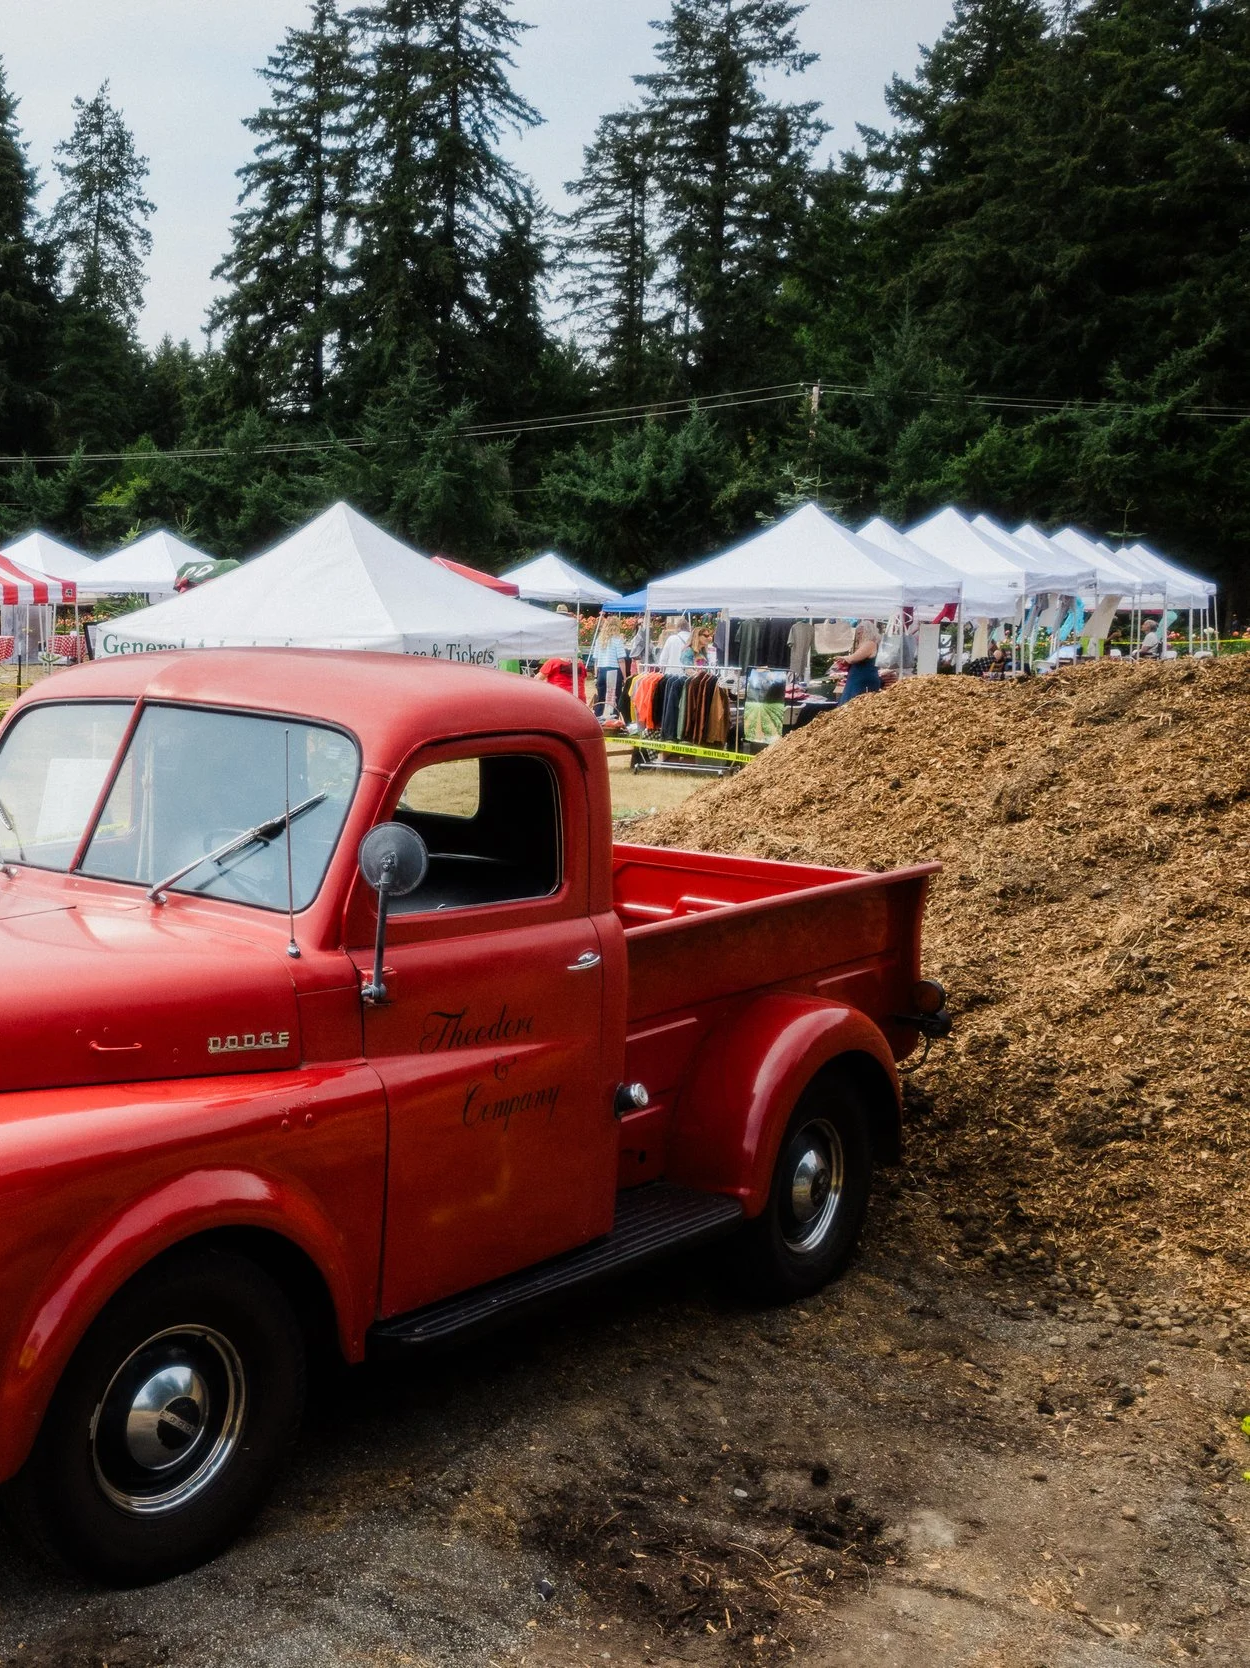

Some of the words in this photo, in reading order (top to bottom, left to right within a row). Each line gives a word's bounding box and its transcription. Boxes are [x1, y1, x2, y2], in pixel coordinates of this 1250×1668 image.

[446, 643, 495, 665] Tickets
[208, 1032, 289, 1053] DODGE
[420, 1004, 534, 1054] Theodore
[494, 1053, 517, 1080] &
[462, 1079, 561, 1132] Company
